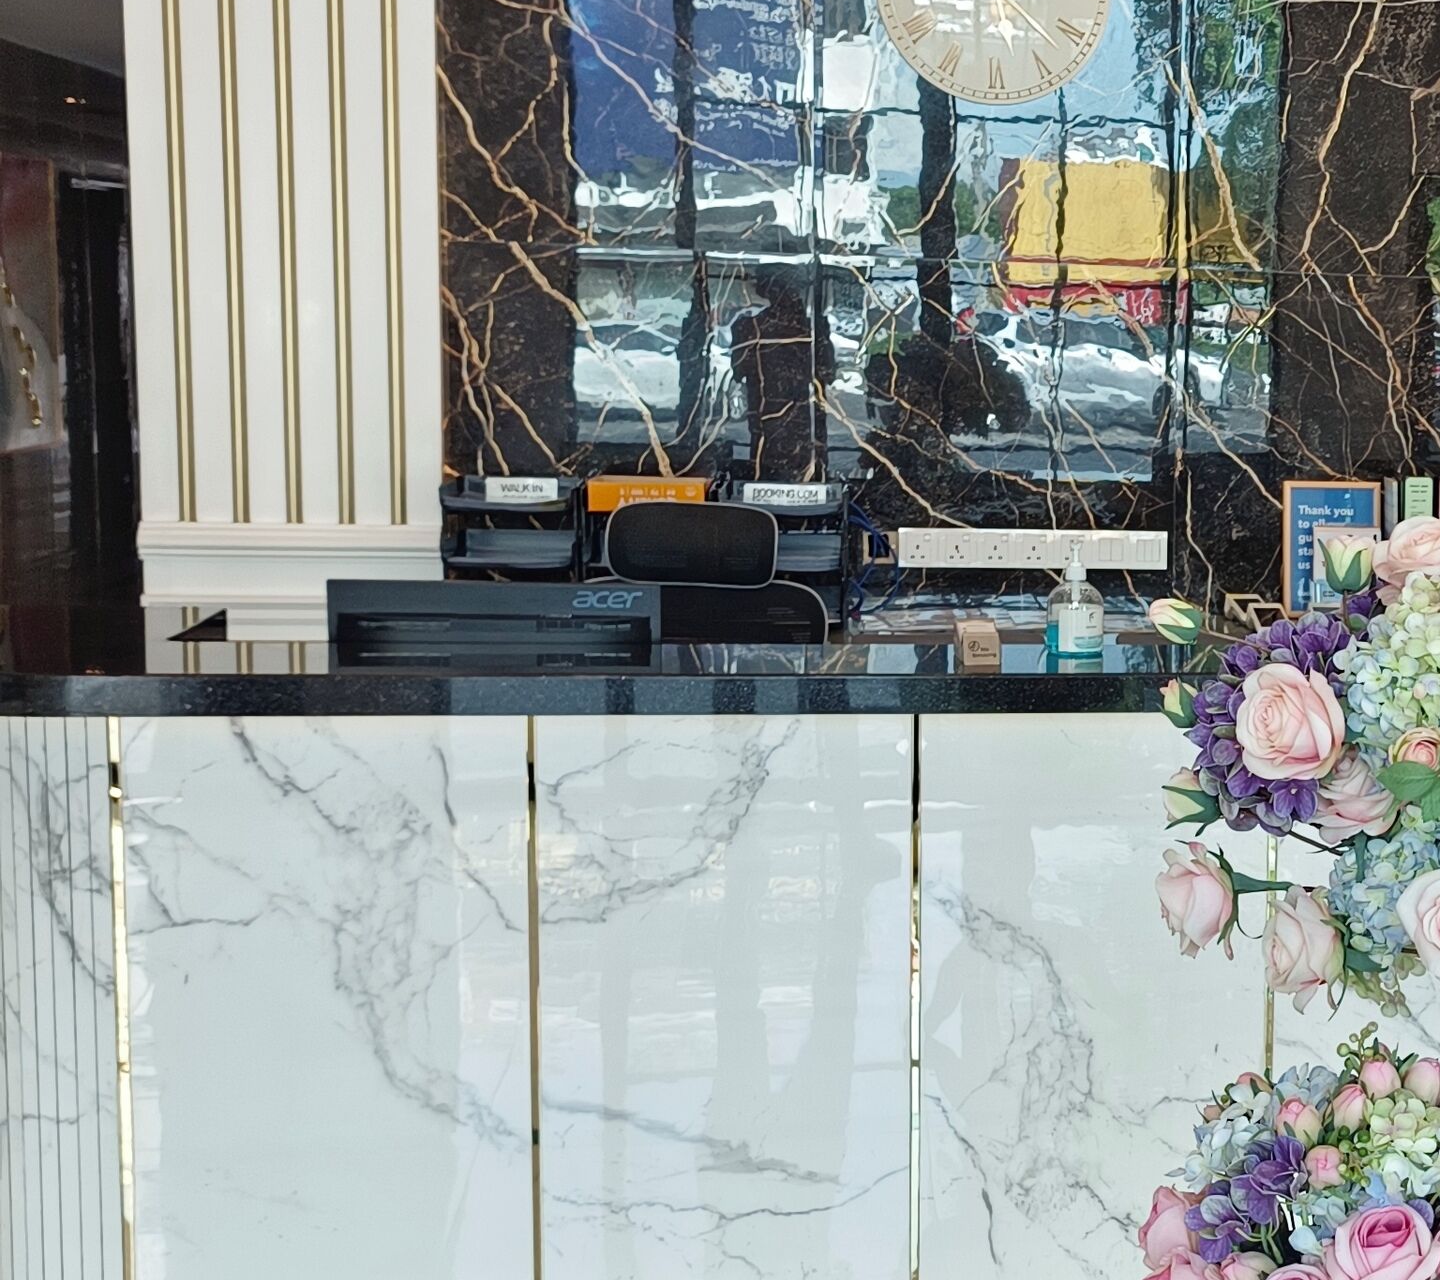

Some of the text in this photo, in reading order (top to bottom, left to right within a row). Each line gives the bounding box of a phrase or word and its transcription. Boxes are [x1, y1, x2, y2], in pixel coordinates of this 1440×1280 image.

[1297, 504, 1354, 518] Thank you
[1297, 520, 1310, 529] to
[1297, 562, 1311, 570] us
[571, 590, 644, 609] acer
